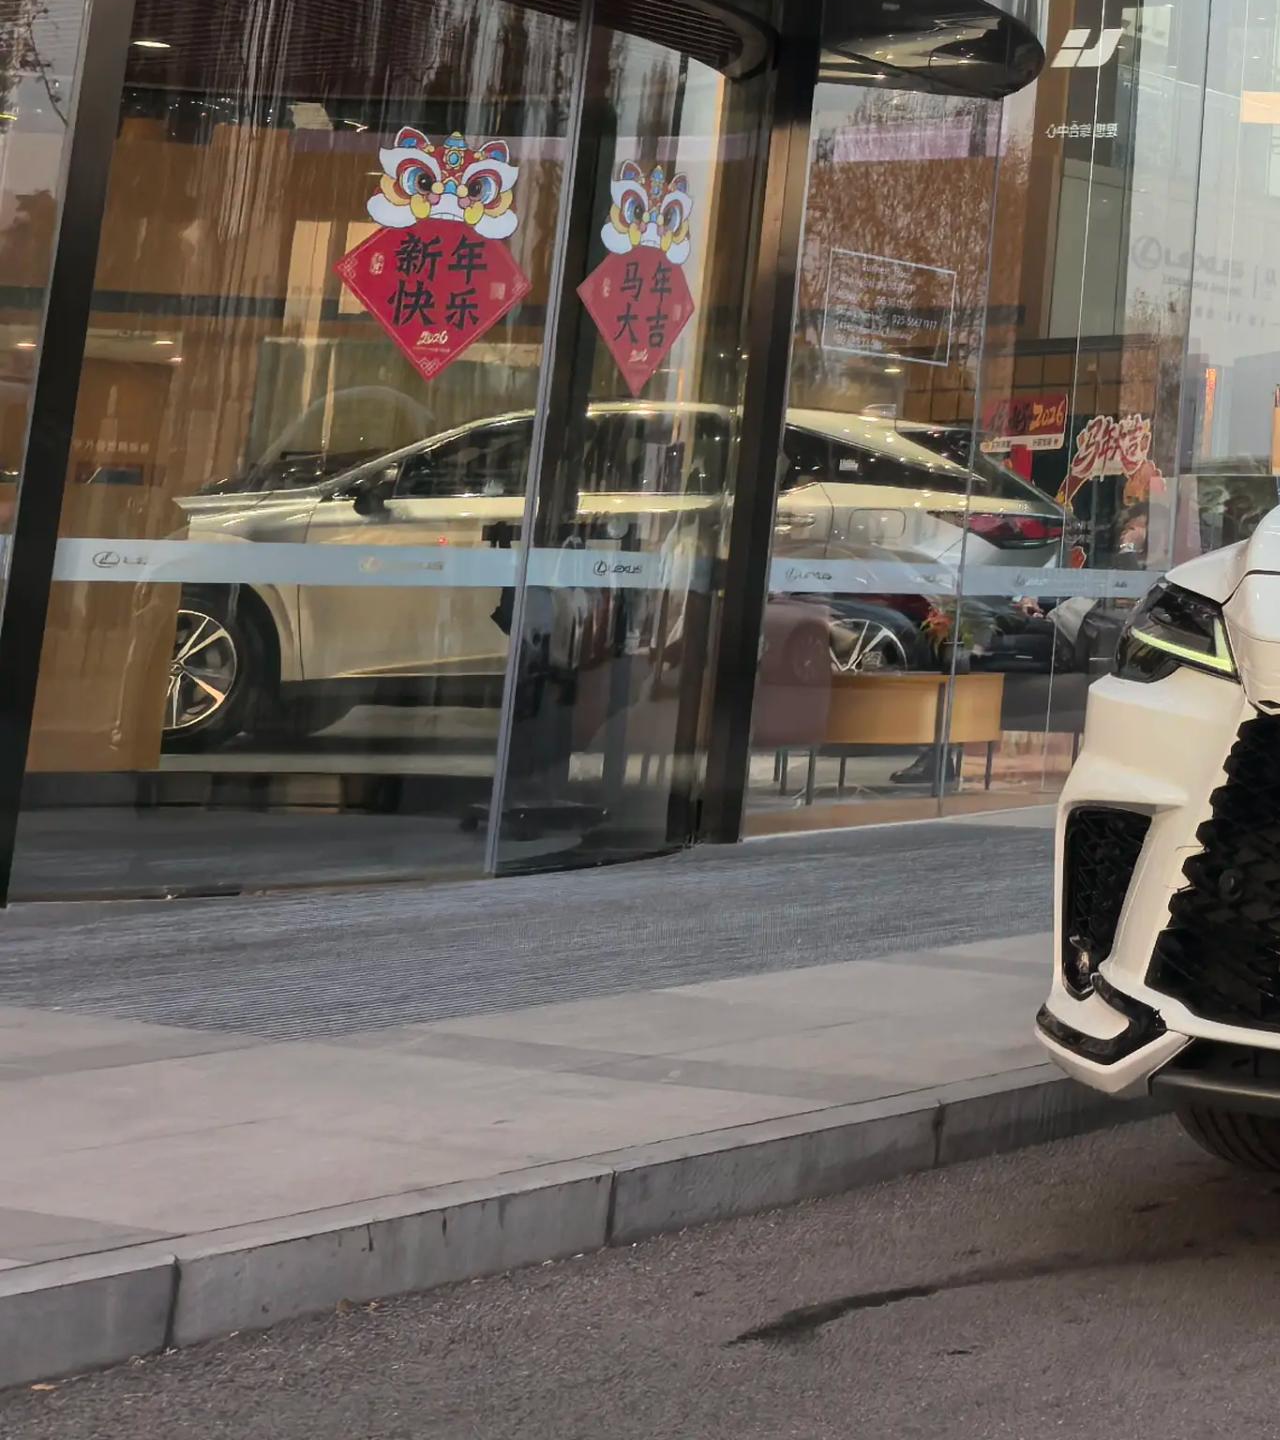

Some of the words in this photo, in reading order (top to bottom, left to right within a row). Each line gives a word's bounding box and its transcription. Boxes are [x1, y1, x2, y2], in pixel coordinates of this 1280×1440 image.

[393, 232, 487, 285] 新年
[387, 278, 480, 331] 快乐
[619, 260, 673, 305] 马年
[613, 303, 669, 349] 大吉
[1028, 399, 1066, 432] 2026
